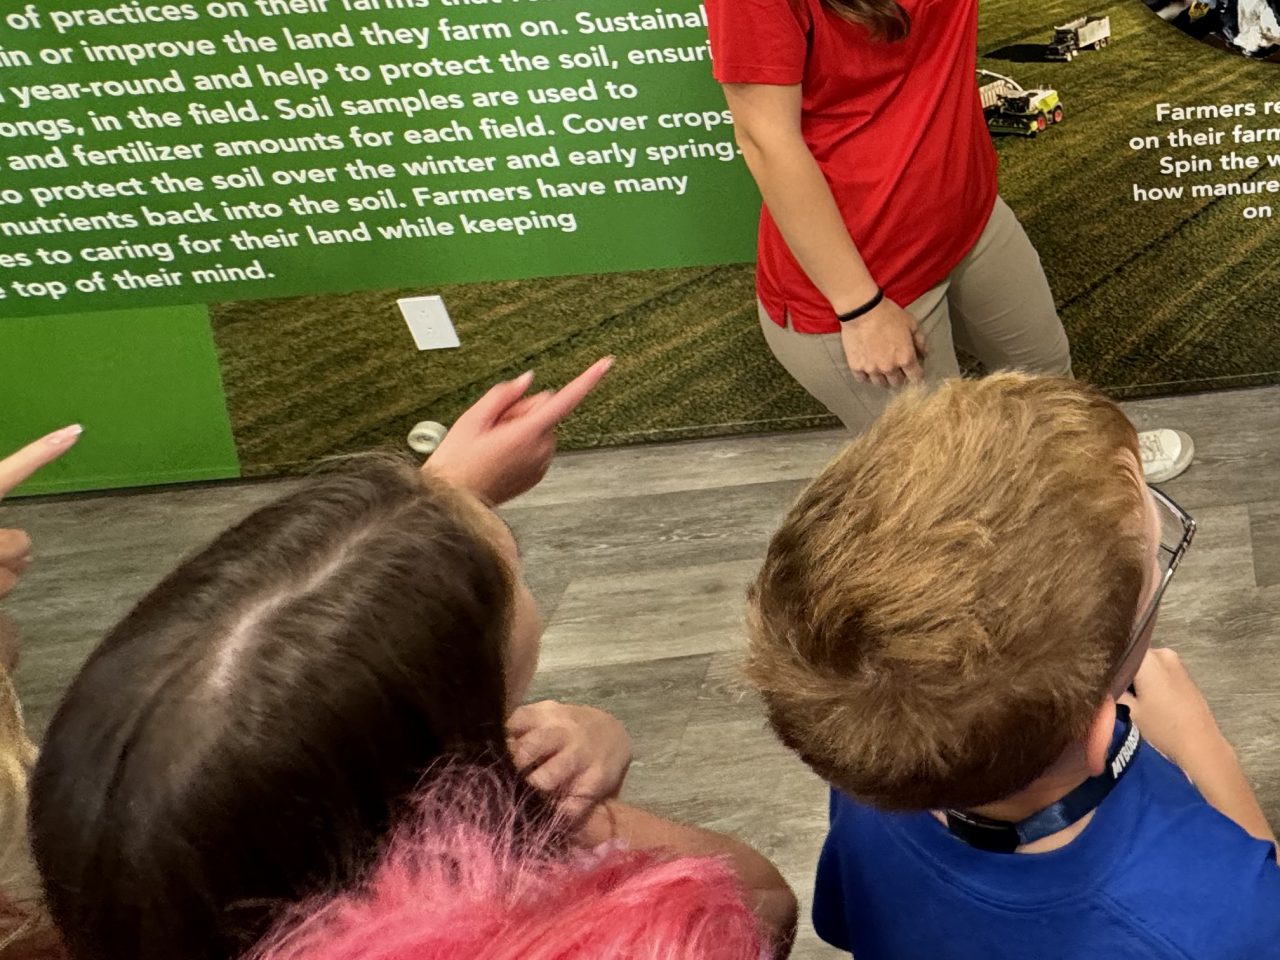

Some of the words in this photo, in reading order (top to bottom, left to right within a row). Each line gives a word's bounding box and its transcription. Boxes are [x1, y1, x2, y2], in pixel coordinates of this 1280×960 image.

[6, 5, 41, 29] of
[50, 1, 199, 33] practices
[40, 48, 73, 64] or
[81, 40, 216, 65] improve
[222, 30, 277, 53] the
[284, 24, 354, 50] land
[360, 22, 429, 49] they
[438, 18, 511, 41] farm
[521, 20, 568, 36] on.
[88, 111, 122, 131] in
[127, 107, 182, 129] the
[188, 100, 269, 124] field.
[274, 95, 334, 120] Soil
[341, 89, 465, 117] samples
[472, 91, 519, 107] are
[528, 79, 598, 104] used
[605, 82, 637, 99] to
[1157, 103, 1256, 121] Farmers
[7, 146, 68, 170] and
[73, 134, 203, 165] fertilizer
[214, 133, 344, 156] amounts
[349, 126, 393, 147] for
[404, 120, 473, 144] each
[479, 115, 555, 139] field.
[563, 114, 648, 134] Cover
[658, 111, 734, 131] crops
[1129, 136, 1159, 150] on
[1167, 128, 1225, 147] their
[1160, 155, 1211, 177] Spin
[1220, 152, 1259, 170] the
[1133, 184, 1183, 201] how
[1192, 180, 1280, 197] manure
[1243, 206, 1271, 218] on
[36, 249, 72, 264] to
[80, 240, 174, 261] caring
[178, 235, 222, 254] for
[230, 229, 299, 250] their
[306, 222, 372, 244] land
[377, 217, 454, 239] while
[460, 211, 577, 235] keeping
[11, 281, 67, 299] top
[75, 271, 106, 292] of
[112, 268, 182, 289] their
[192, 260, 275, 283] mind.
